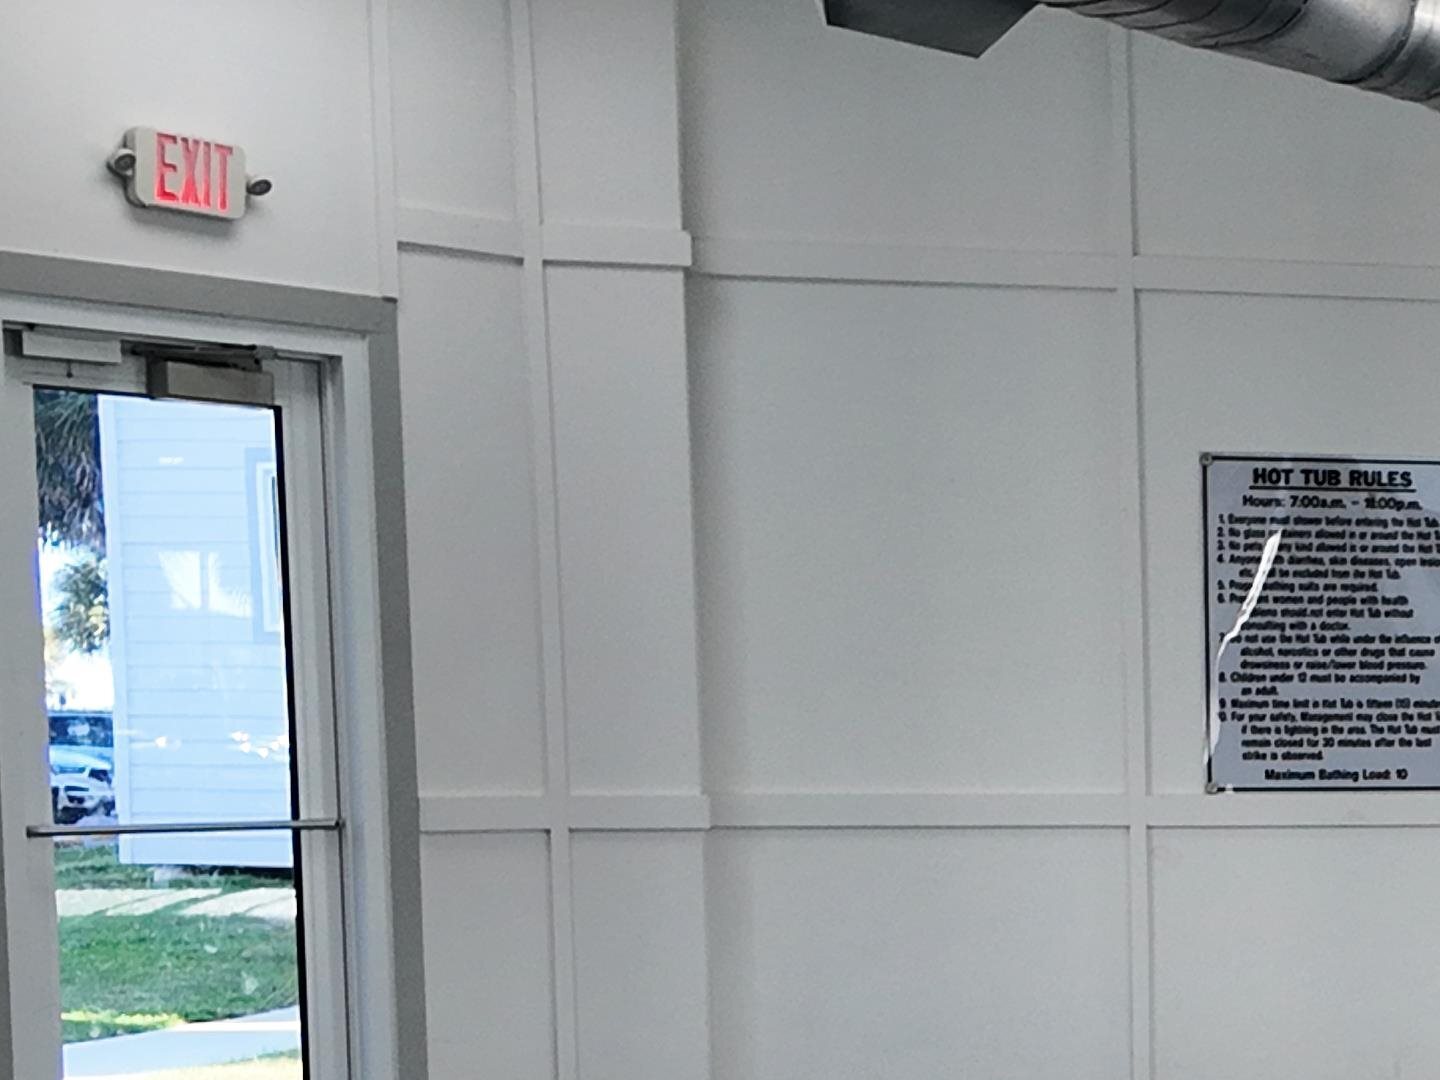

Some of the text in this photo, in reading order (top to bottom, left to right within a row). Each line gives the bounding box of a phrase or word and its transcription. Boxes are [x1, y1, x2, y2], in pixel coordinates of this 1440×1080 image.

[156, 132, 233, 213] EXIT
[1252, 467, 1413, 487] HOT TUB RULES
